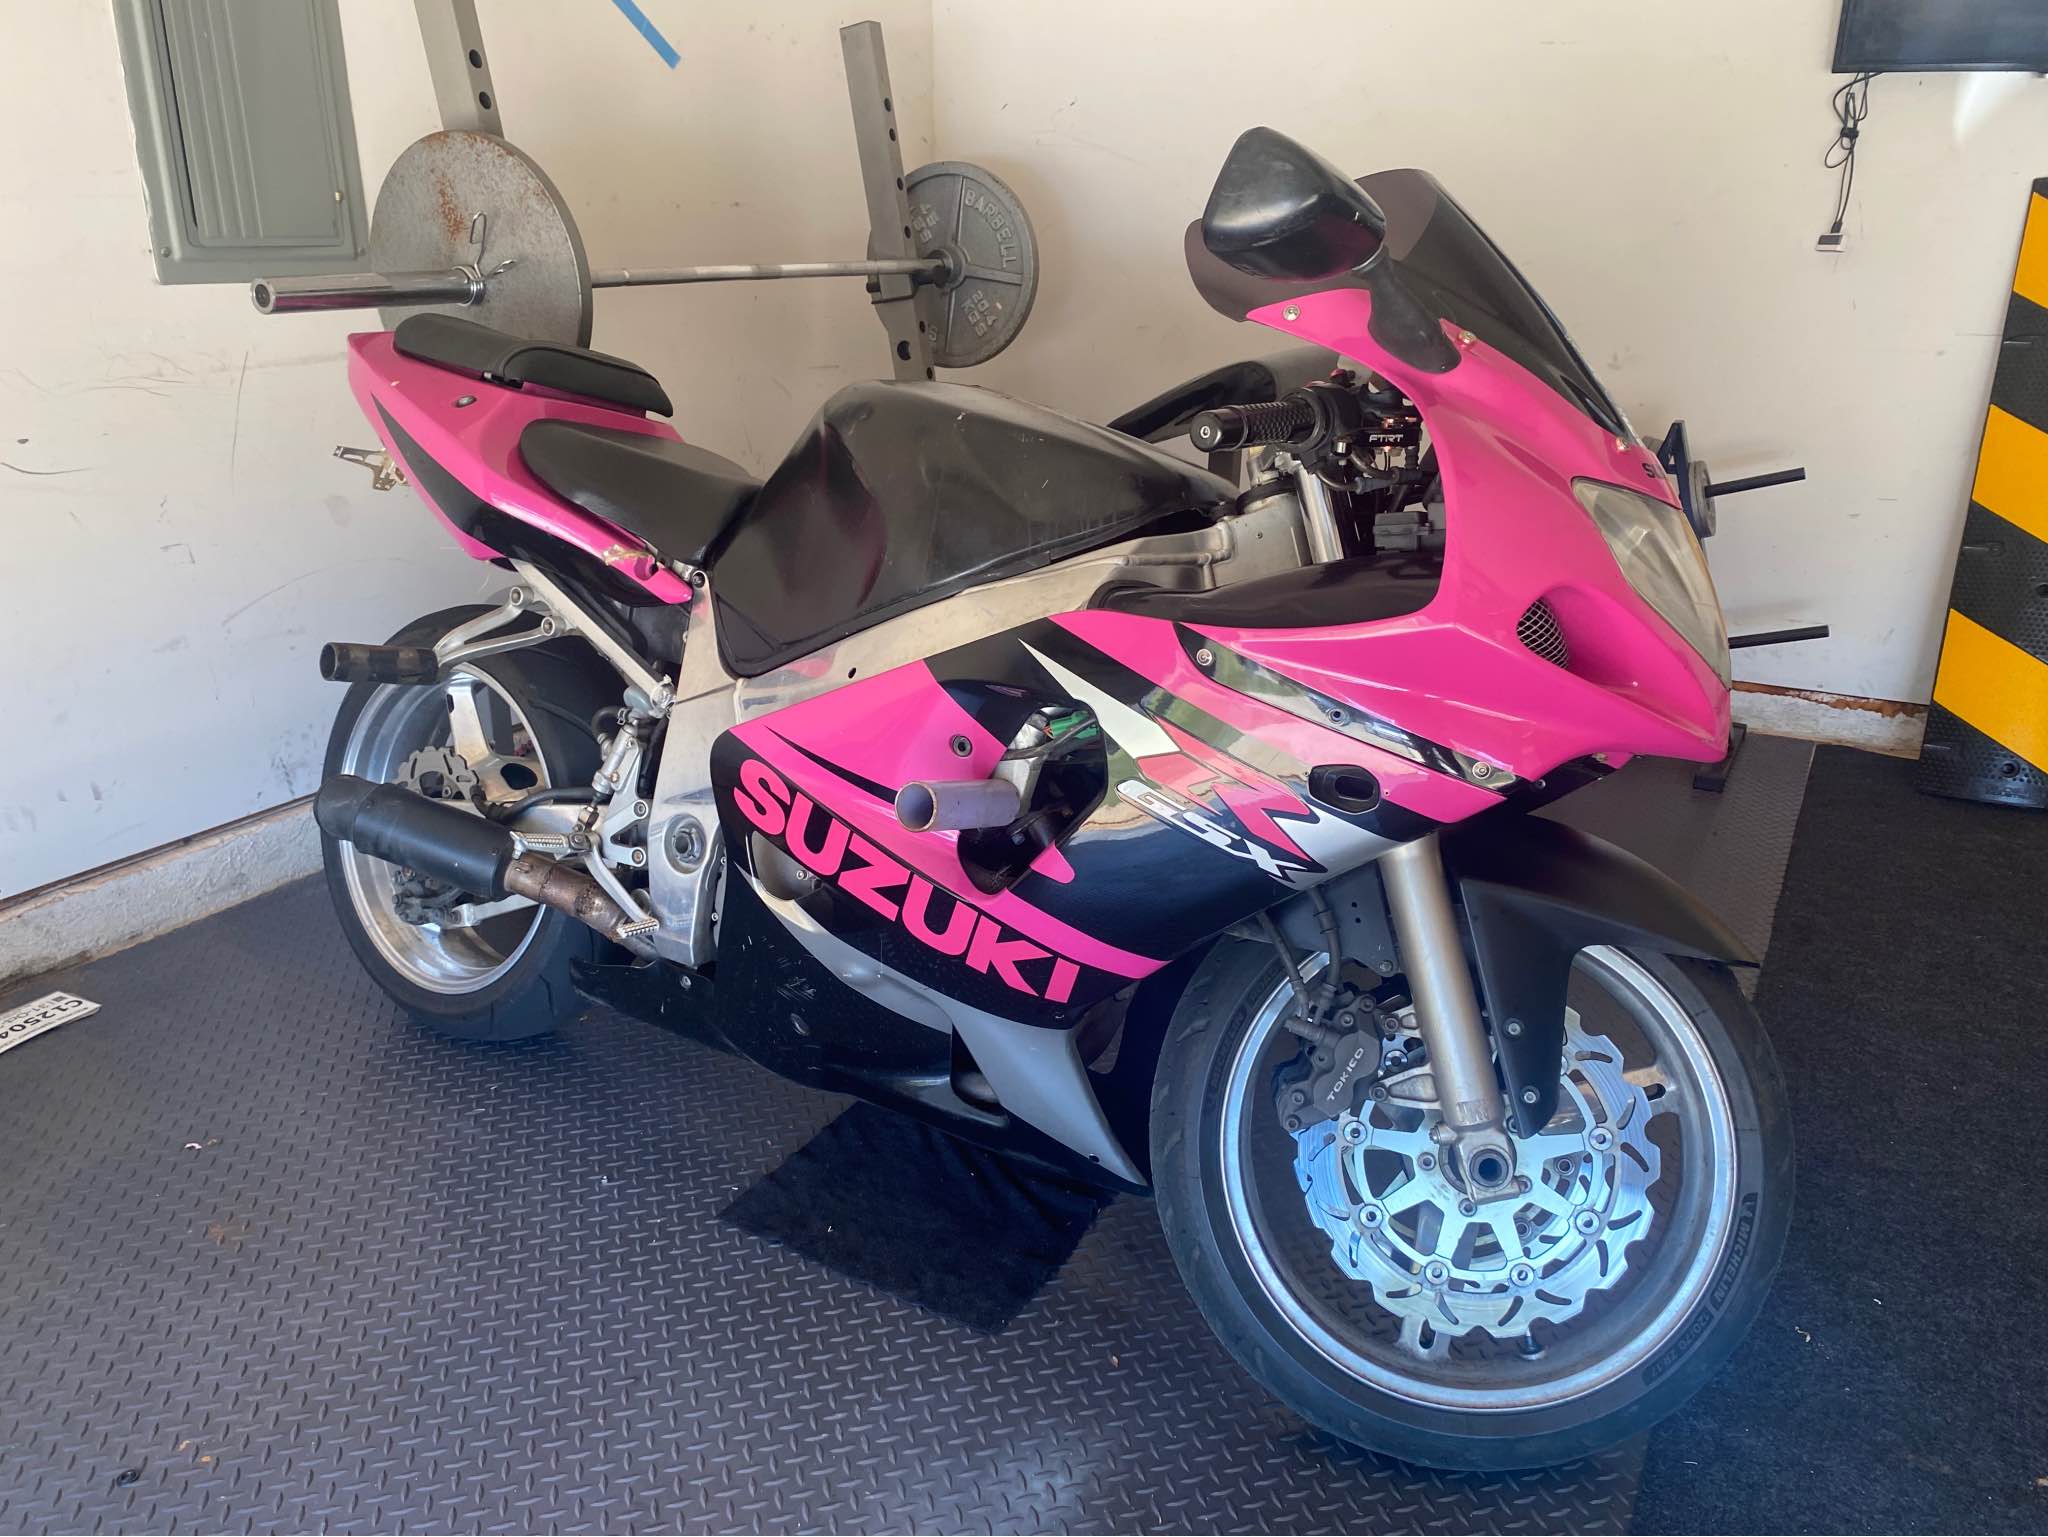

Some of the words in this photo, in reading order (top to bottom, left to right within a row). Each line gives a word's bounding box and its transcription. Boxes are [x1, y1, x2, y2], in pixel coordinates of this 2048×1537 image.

[964, 190, 1017, 268] BARBELL
[1368, 433, 1404, 444] FTRT
[733, 759, 1081, 1004] SUZUKI
[1327, 1047, 1364, 1101] TOKICO
[1713, 1220, 1750, 1302] MICHELIN
